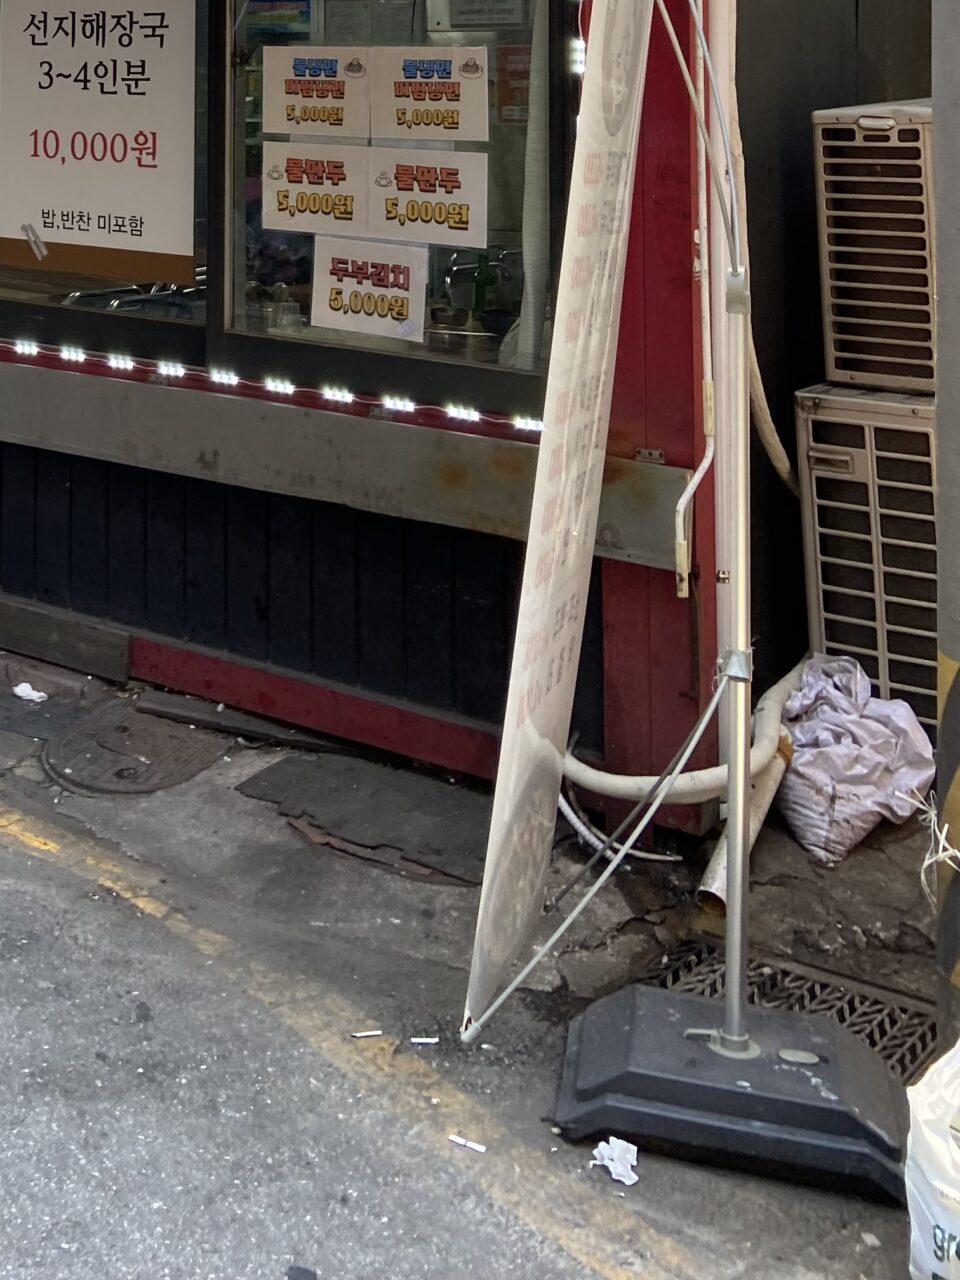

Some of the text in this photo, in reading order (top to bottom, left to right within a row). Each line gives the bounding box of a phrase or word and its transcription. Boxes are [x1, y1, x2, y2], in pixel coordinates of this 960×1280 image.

[23, 11, 170, 49] 선지해장국
[38, 59, 151, 97] 3~4인분
[293, 58, 338, 78] 물냉면
[403, 59, 452, 79] 물냉면
[286, 105, 344, 126] 5,000원
[396, 108, 459, 130] 5,000원
[29, 129, 159, 168] 10,000원
[285, 158, 346, 186] 물만두
[394, 164, 461, 194] 물만두
[277, 190, 354, 221] 5,000원
[385, 198, 469, 231] 5,000원
[41, 208, 145, 237] 밥,반찬 미포함
[330, 257, 410, 291] 두부김치
[329, 288, 409, 321] 5,000원
